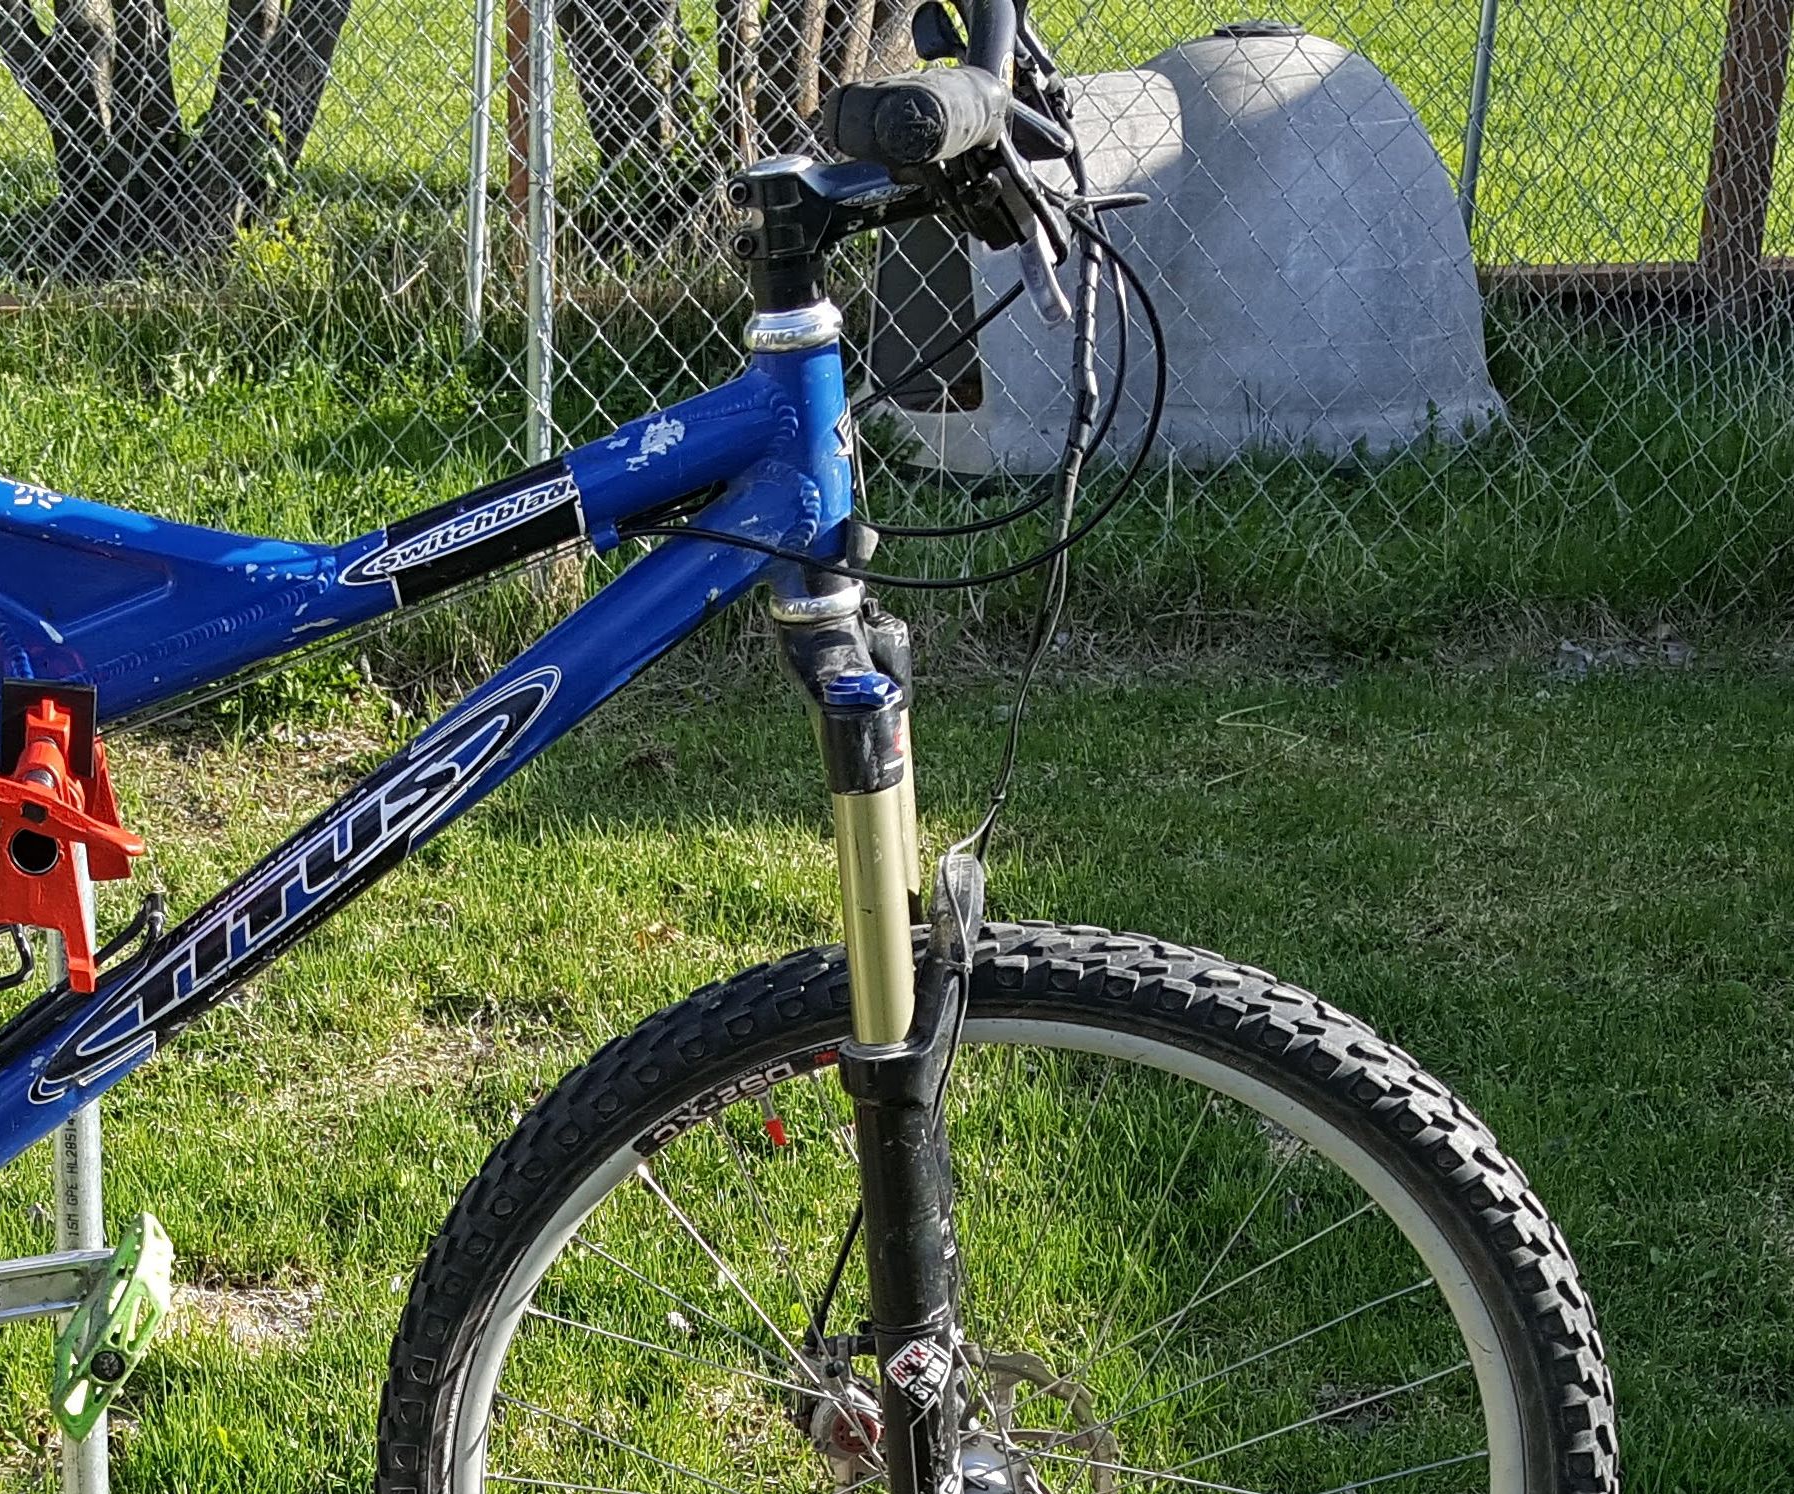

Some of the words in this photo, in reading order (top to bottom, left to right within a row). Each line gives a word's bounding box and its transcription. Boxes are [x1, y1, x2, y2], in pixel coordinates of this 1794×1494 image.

[756, 330, 795, 346] KING
[782, 600, 822, 615] KING
[111, 738, 466, 1028] TITUS
[66, 1182, 79, 1207] GPE
